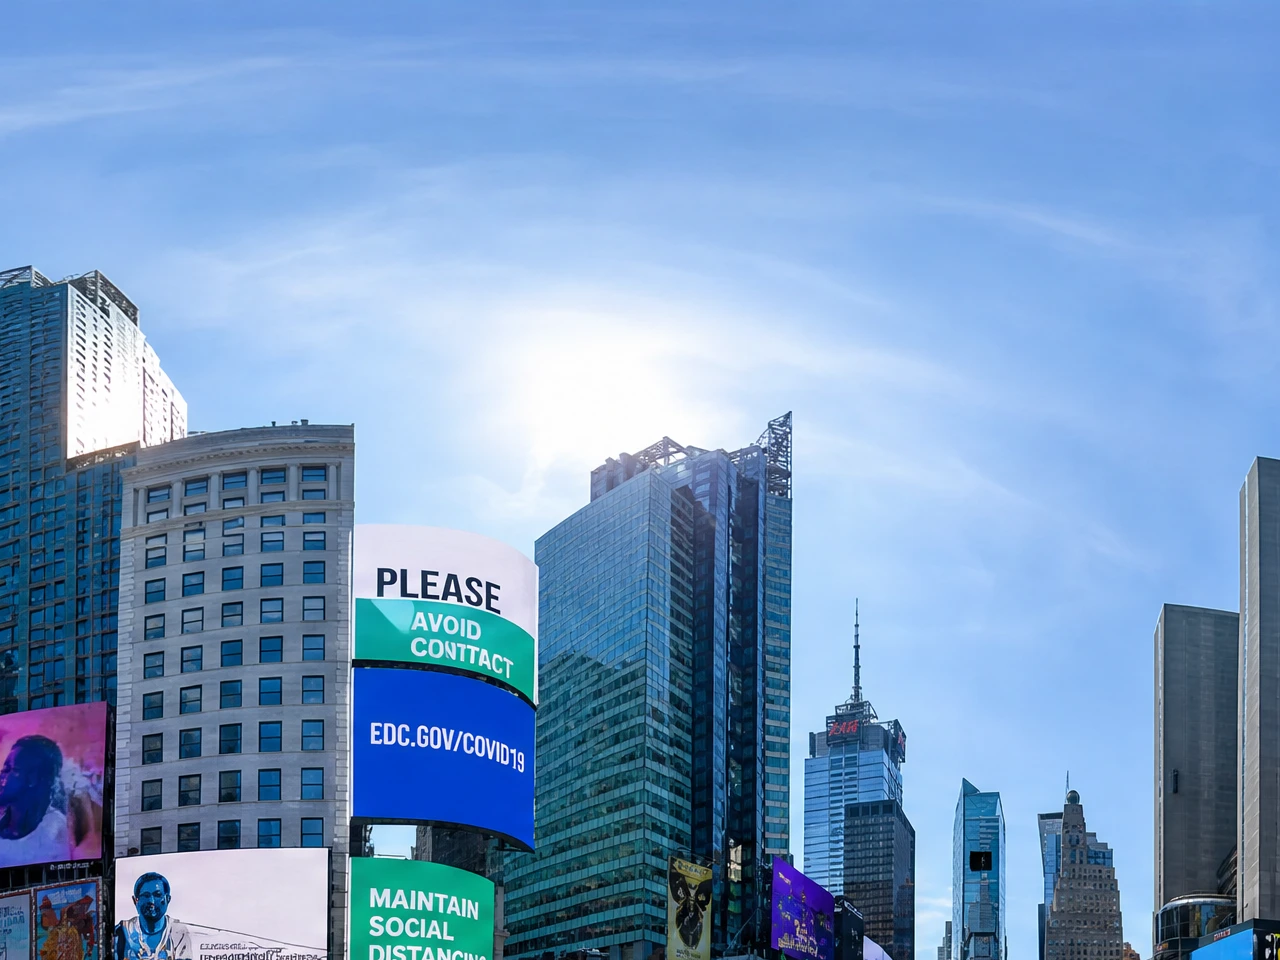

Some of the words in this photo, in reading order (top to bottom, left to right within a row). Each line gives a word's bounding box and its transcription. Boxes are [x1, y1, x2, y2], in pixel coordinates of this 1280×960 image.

[376, 567, 501, 615] PLEASE
[411, 611, 482, 640] AVOID
[369, 887, 479, 920] MAINTAIN
[369, 915, 454, 941] SOCIAL
